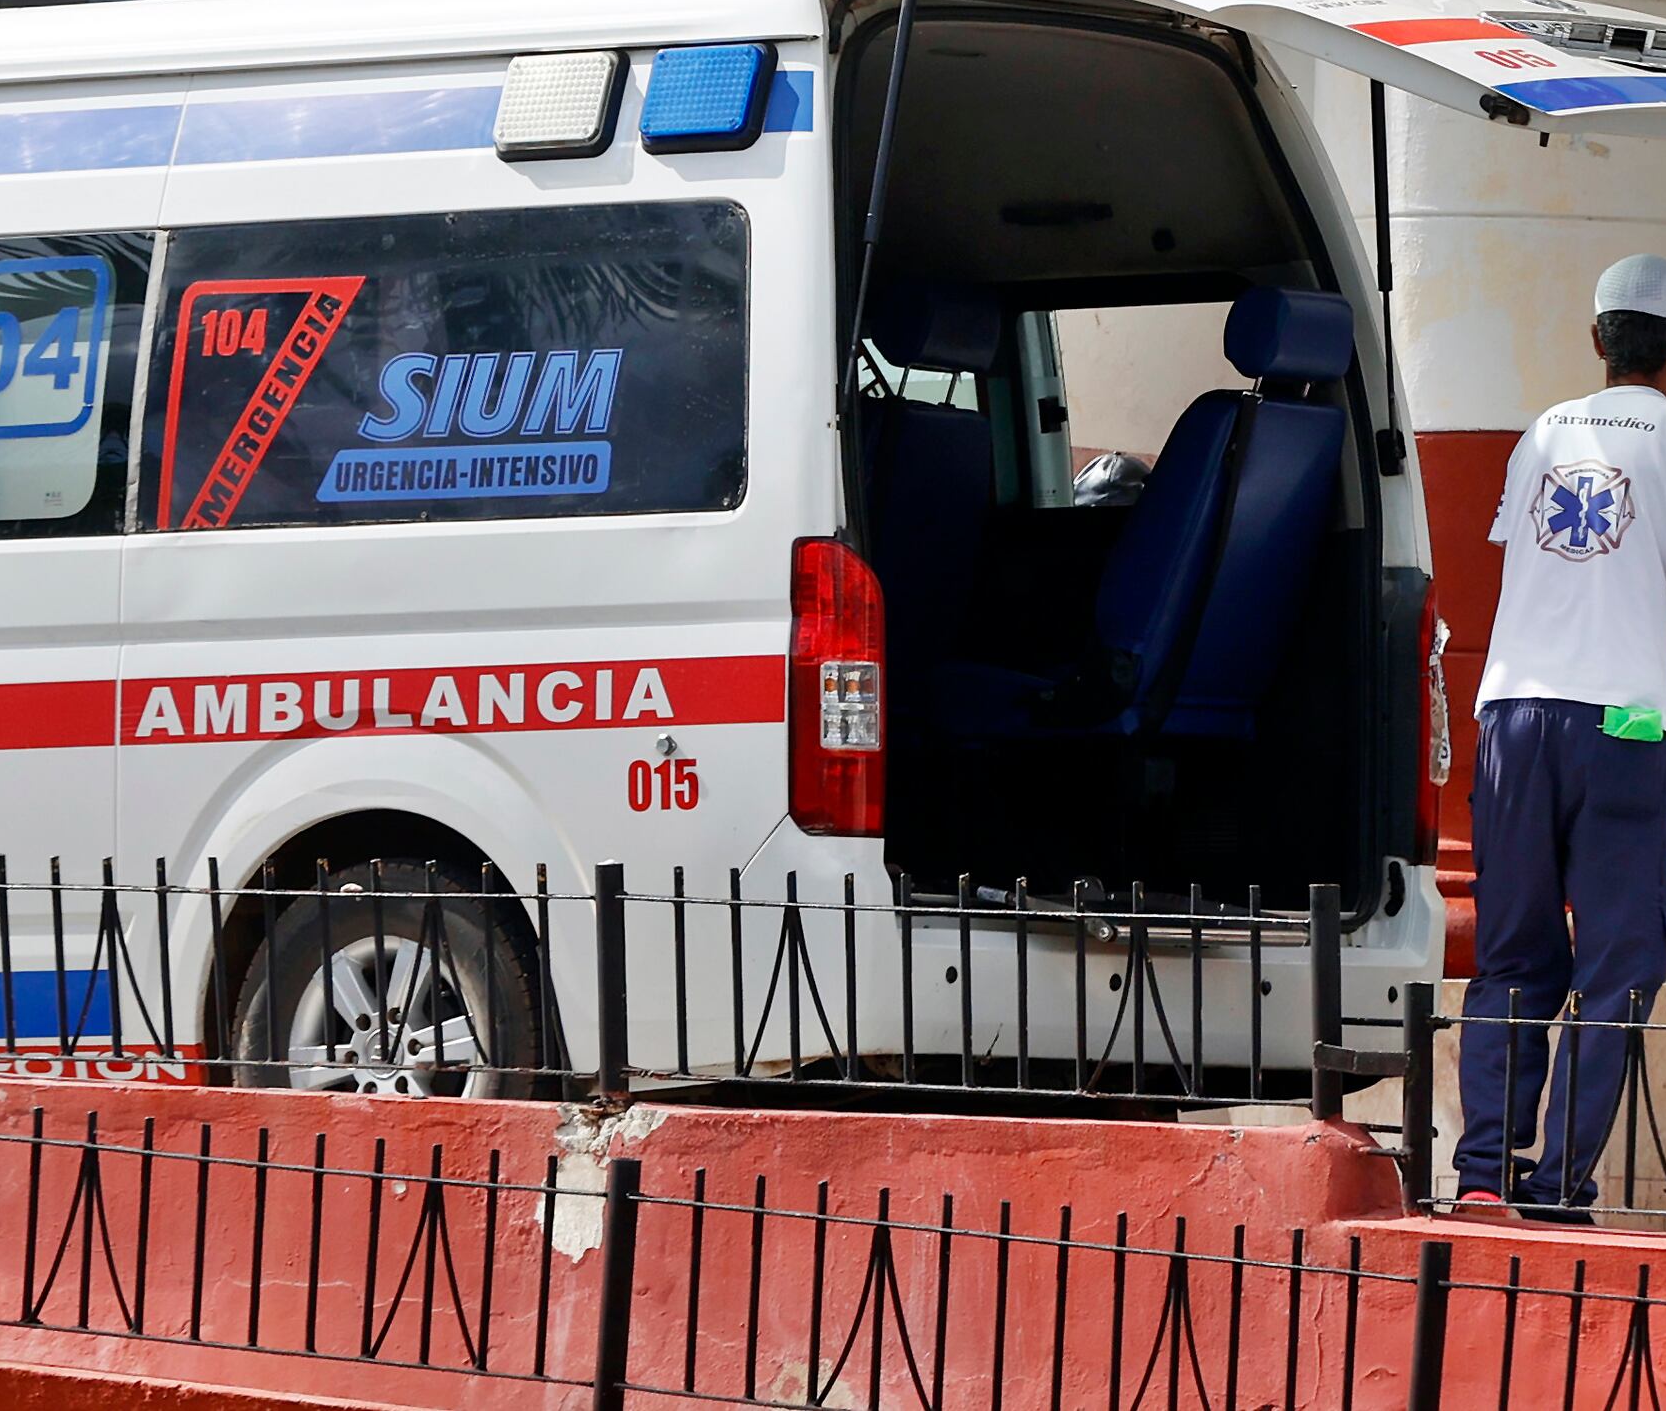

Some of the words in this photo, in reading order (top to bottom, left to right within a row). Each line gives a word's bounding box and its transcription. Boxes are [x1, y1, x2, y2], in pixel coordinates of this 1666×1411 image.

[1473, 48, 1558, 70] 015
[201, 308, 269, 357] 104
[357, 348, 624, 442] SIUM
[334, 453, 599, 493] URGENCIA-INTENSIVO
[134, 667, 675, 738] AMBULANCIA
[626, 757, 700, 812] 015
